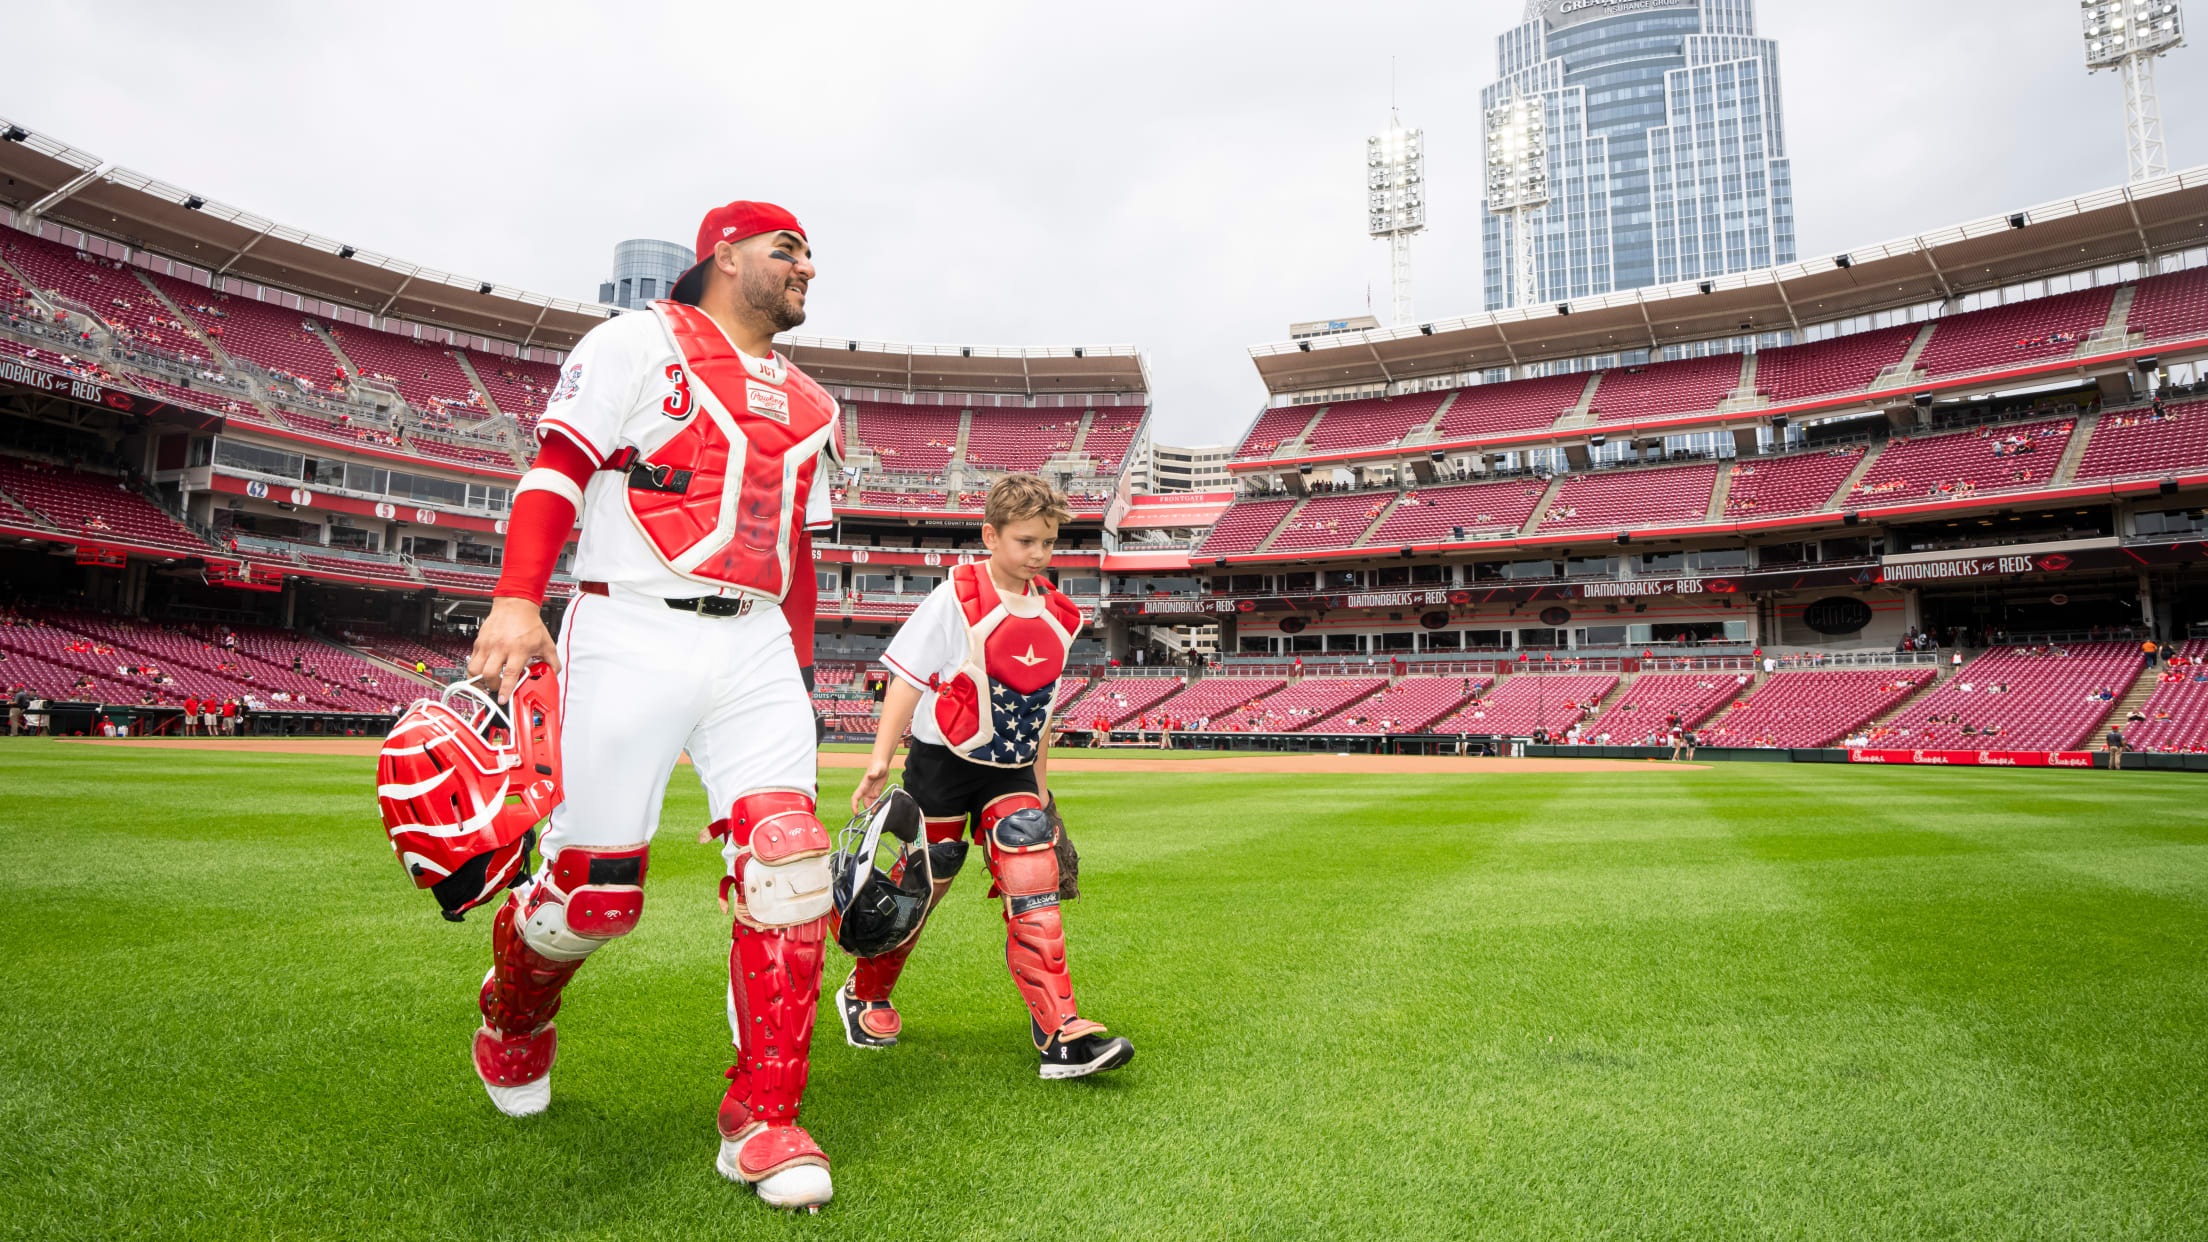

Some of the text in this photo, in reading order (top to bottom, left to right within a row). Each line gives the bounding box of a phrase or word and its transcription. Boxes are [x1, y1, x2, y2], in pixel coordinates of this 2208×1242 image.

[1604, 1, 1650, 14] INSURANCE
[71, 380, 102, 402] REDS
[661, 363, 694, 421] 3
[249, 481, 265, 497] 42
[1160, 495, 1204, 503] FRONTGATE
[419, 508, 434, 524] 20
[855, 550, 866, 562] 10
[1883, 560, 1980, 581] DIAMONDBACKS
[1999, 556, 2033, 573] REDS
[1584, 581, 1662, 597] DIAMONDBACKS
[1676, 579, 1703, 593] REDS
[1144, 602, 1205, 614] DIAMONDBACKS
[1216, 600, 1236, 612] REDS
[1348, 593, 1413, 608] DIAMONDBACKS
[1425, 591, 1448, 605] REDS
